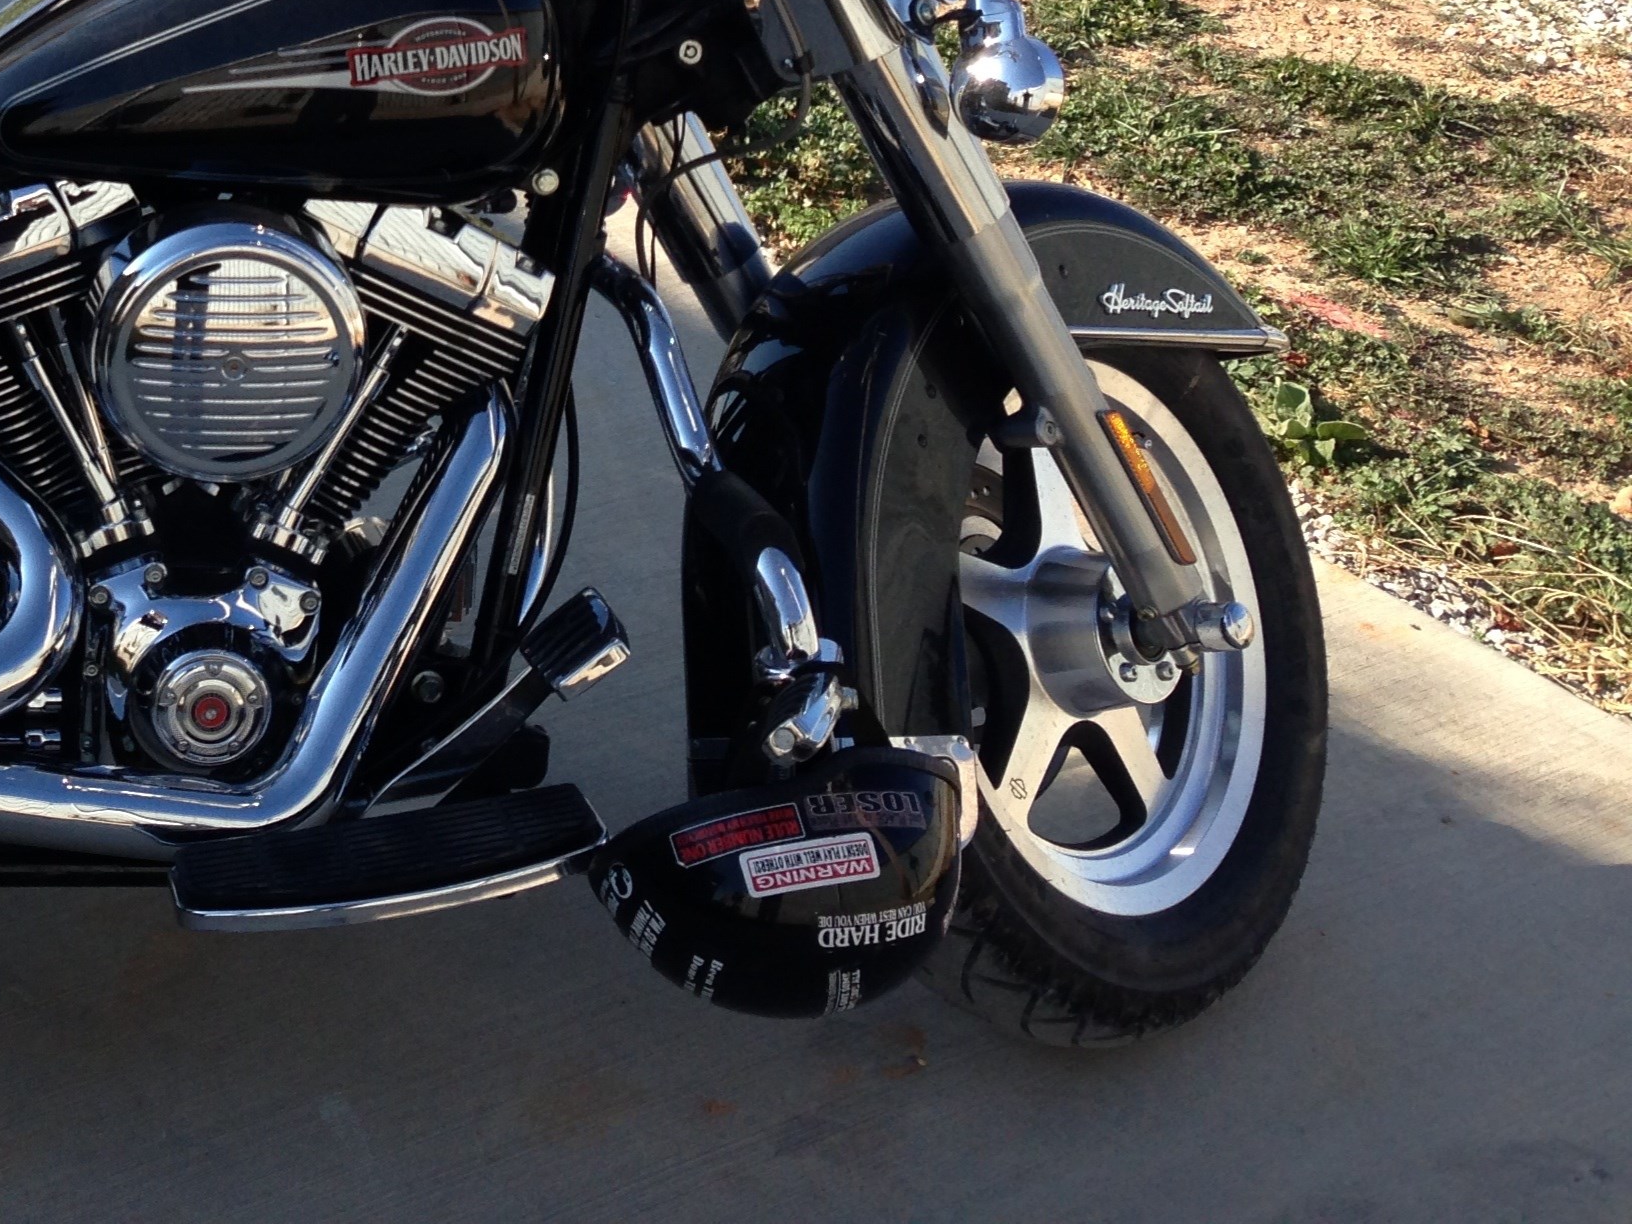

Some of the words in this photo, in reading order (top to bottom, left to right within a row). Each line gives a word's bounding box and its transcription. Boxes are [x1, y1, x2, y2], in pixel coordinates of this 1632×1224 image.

[1101, 282, 1167, 319] Heritage
[1165, 288, 1214, 319] Softail
[807, 791, 922, 816] LOSER
[784, 853, 803, 869] WITH
[804, 849, 822, 865] WELL
[823, 845, 840, 862] PLAY
[755, 858, 872, 890] WARNING
[879, 908, 897, 924] REST
[897, 905, 912, 920] CAN
[913, 901, 927, 915] YOU
[817, 915, 833, 928] DIE
[834, 914, 853, 928] YOU
[853, 911, 878, 926] WHEN
[817, 923, 880, 948] HARD
[884, 912, 927, 943] RIDE
